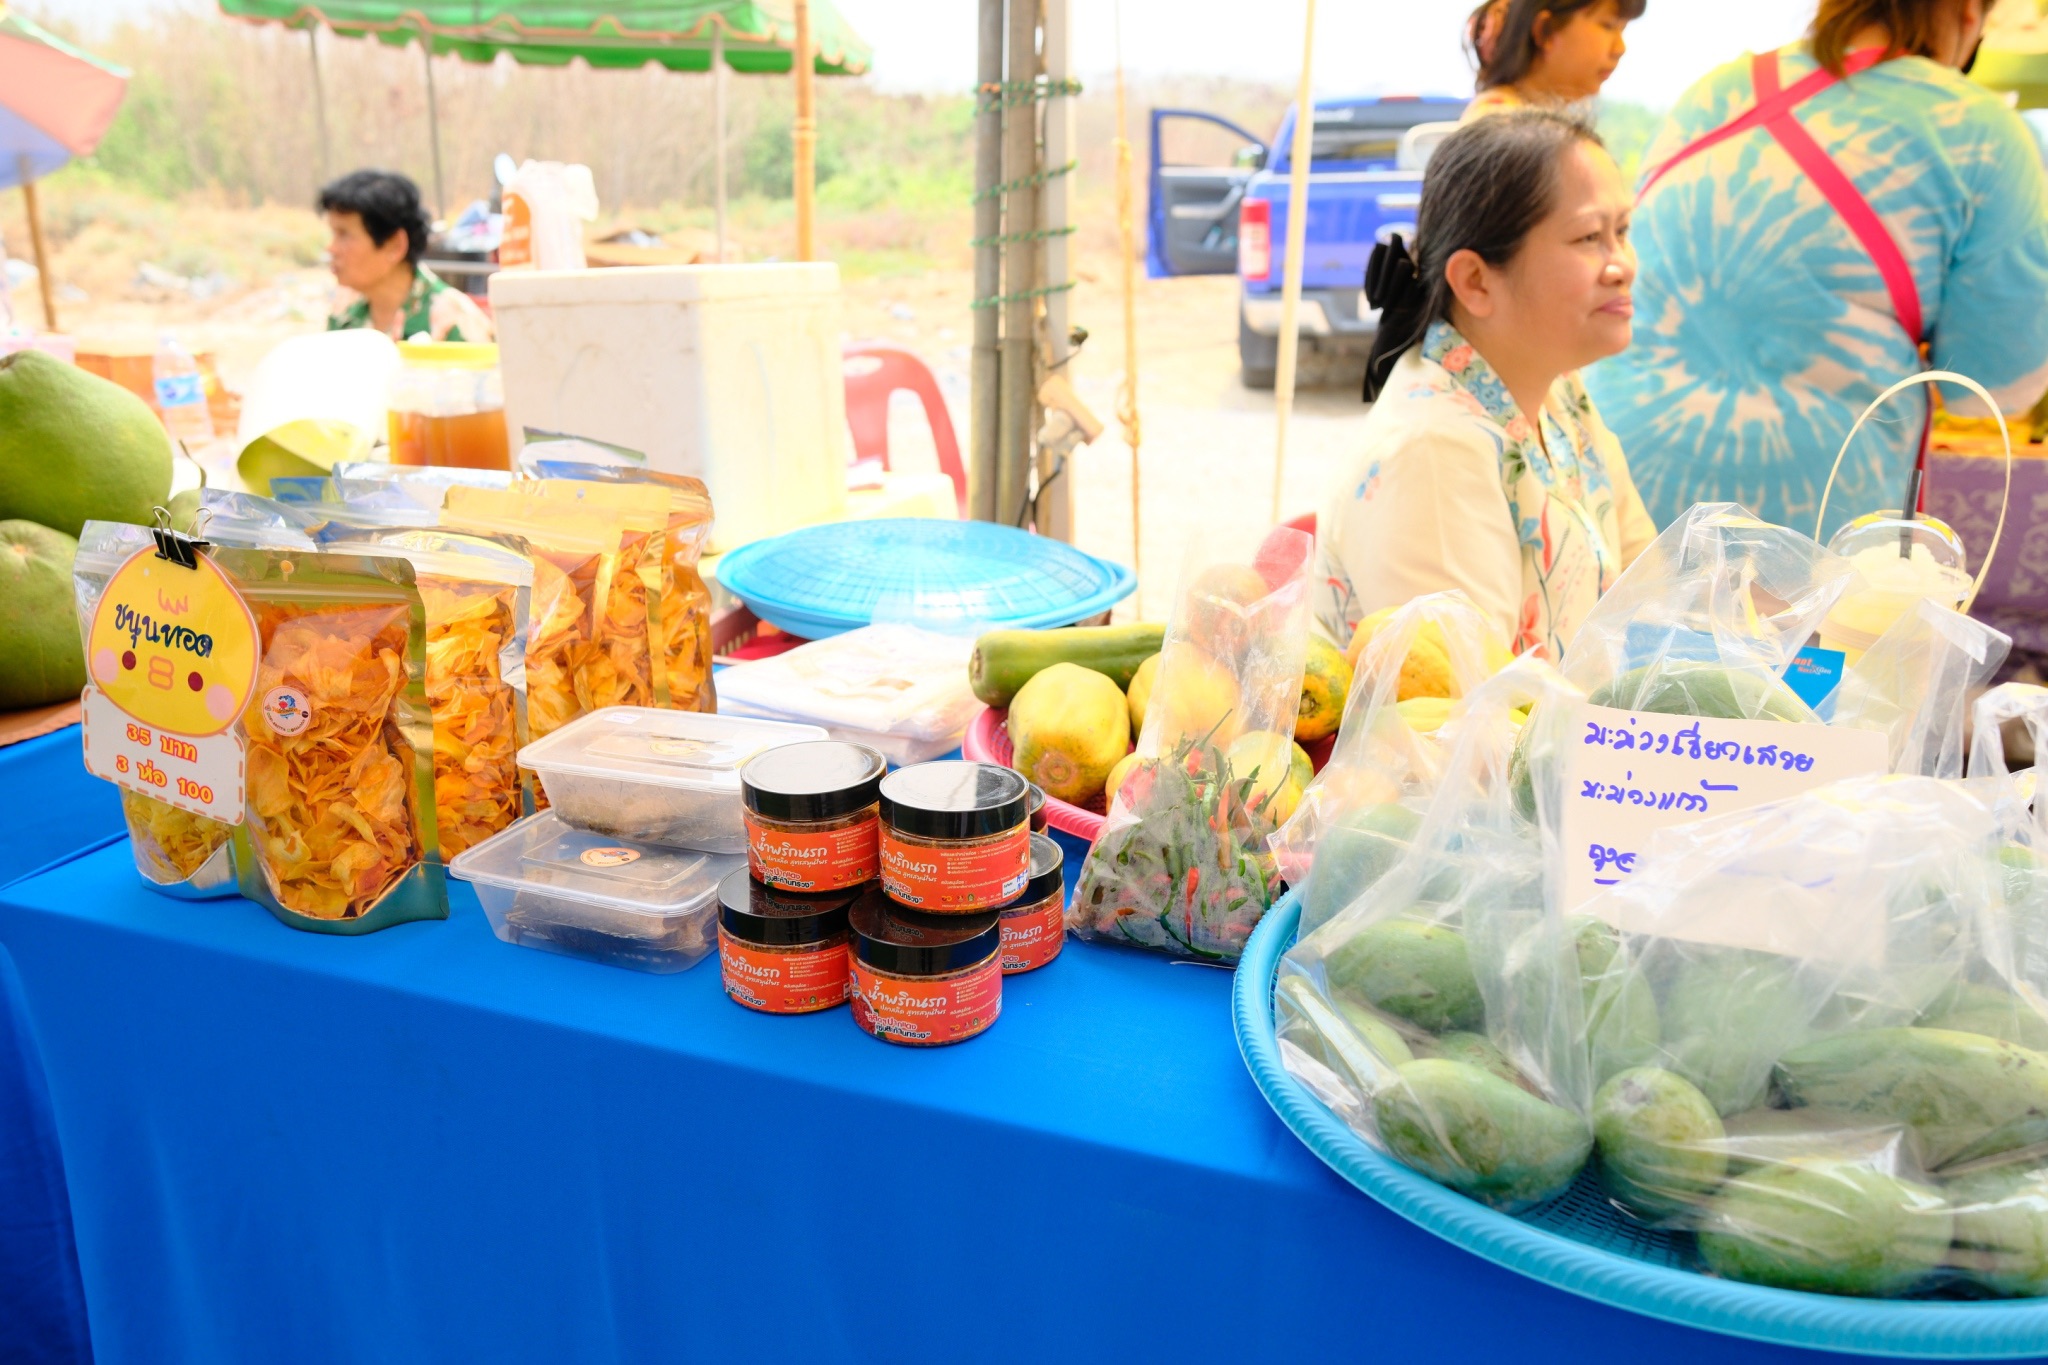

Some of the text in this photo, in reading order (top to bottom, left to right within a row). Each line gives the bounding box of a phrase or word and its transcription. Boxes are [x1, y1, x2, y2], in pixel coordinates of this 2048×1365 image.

[115, 603, 213, 658] ขนุนทอด
[127, 723, 197, 763] 35 บาท
[116, 755, 213, 804] 3 ห่อ 100
[757, 831, 827, 858] น้ำพริกนรก
[880, 838, 937, 874] น้ำพริกนรก
[868, 979, 947, 1008] น้ำพริกนรก
